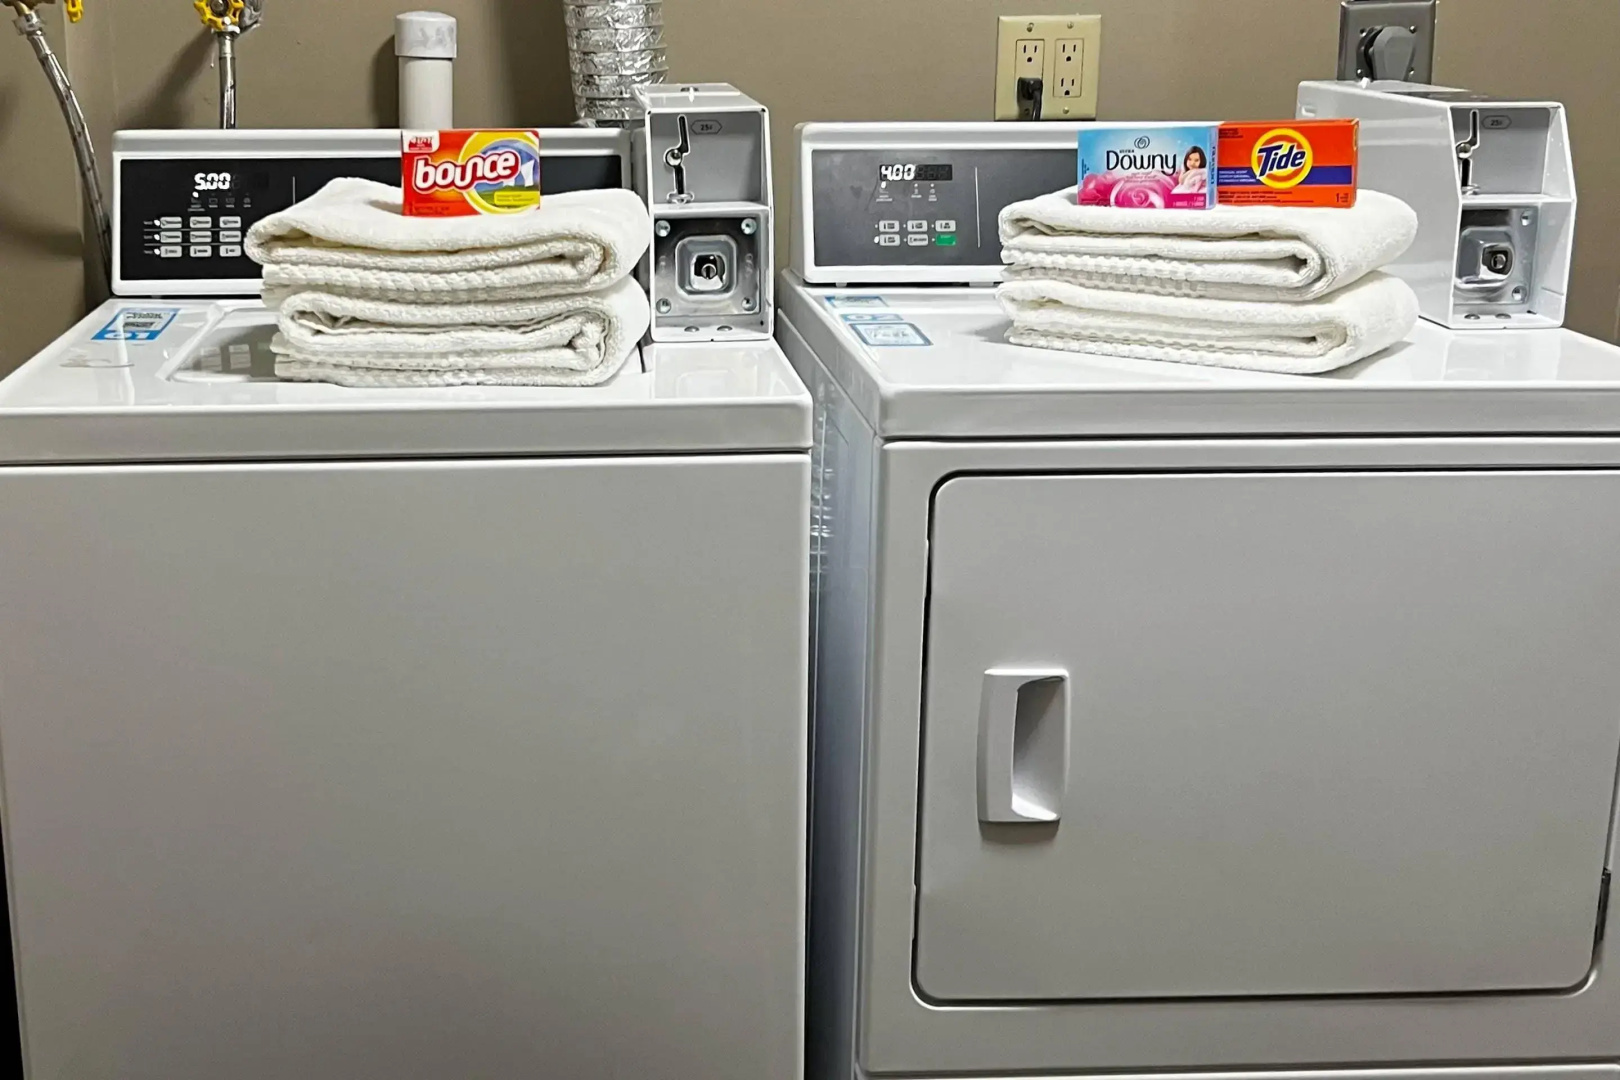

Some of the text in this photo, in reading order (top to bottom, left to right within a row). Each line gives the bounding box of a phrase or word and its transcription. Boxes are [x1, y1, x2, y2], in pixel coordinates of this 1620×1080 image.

[414, 151, 518, 190] bounce
[1106, 150, 1177, 176] Downy
[1257, 143, 1306, 178] Tide
